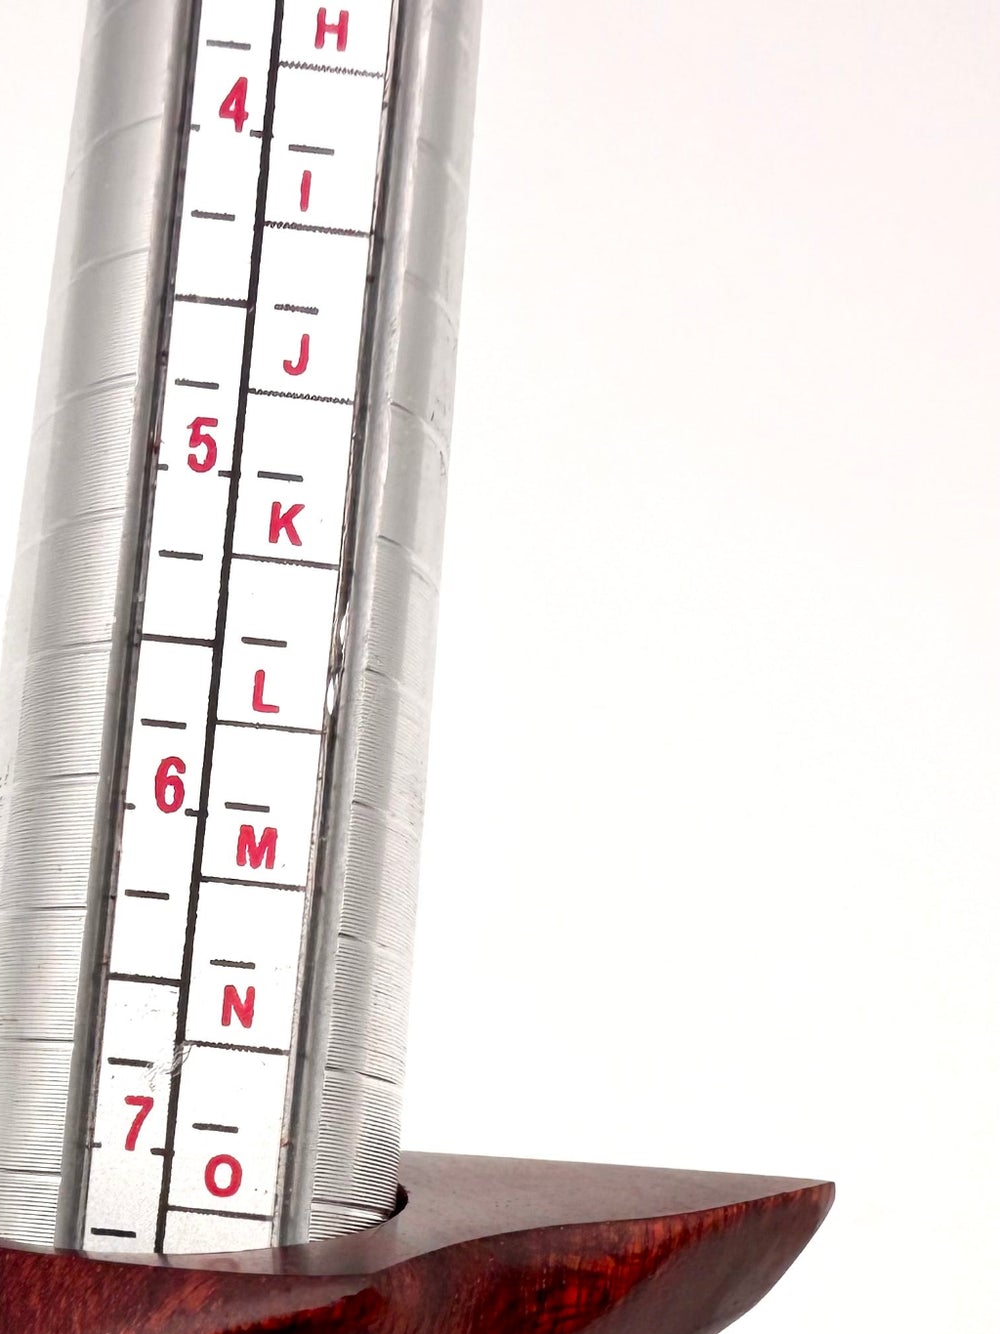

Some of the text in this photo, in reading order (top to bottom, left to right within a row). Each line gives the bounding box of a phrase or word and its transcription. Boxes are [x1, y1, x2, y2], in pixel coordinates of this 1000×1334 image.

[315, 8, 349, 51] H
[219, 76, 249, 132] 4
[300, 170, 312, 211] I
[283, 334, 310, 376] J
[187, 416, 218, 473] 5
[268, 501, 304, 546] K
[252, 669, 279, 713] L
[154, 756, 186, 814] 6
[236, 824, 278, 869] M
[221, 985, 256, 1028] N
[125, 1095, 154, 1151] 7
[204, 1154, 243, 1198] O
